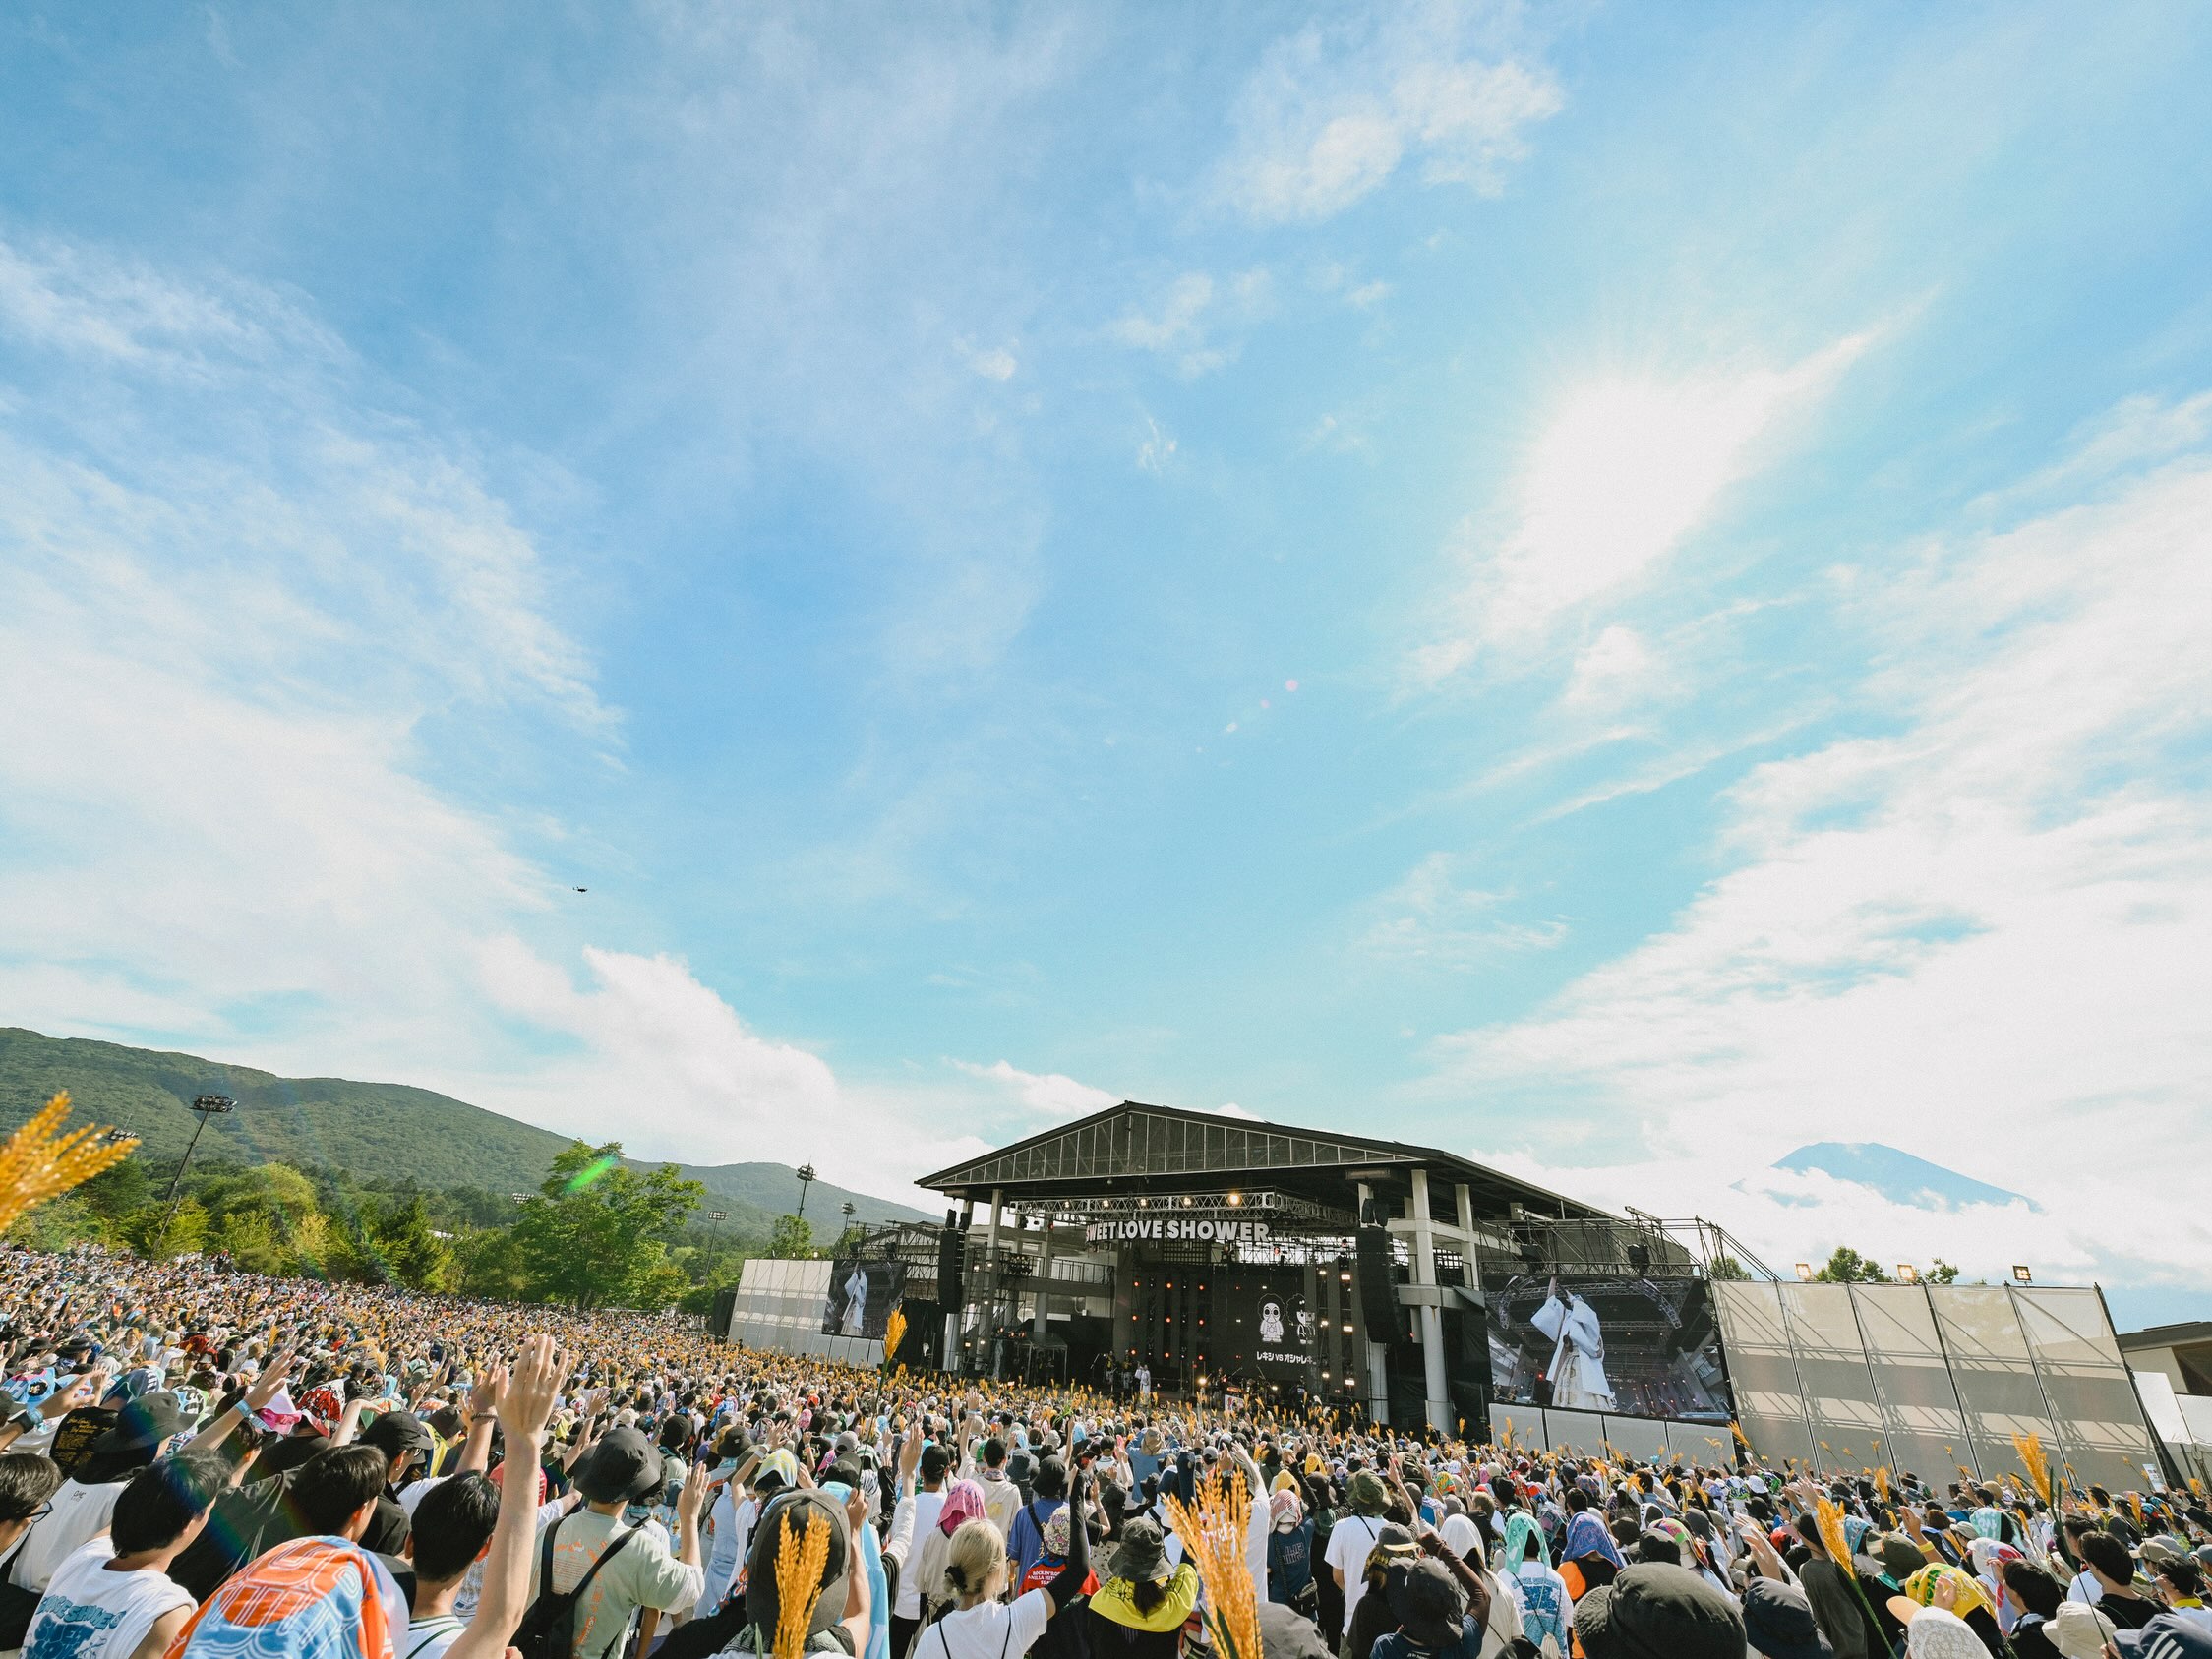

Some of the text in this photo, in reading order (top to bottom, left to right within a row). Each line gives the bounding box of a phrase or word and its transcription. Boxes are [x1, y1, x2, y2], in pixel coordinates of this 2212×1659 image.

[1086, 1220, 1269, 1242] SWEET LOVE SHOWER
[1256, 1351, 1274, 1362] レキシ
